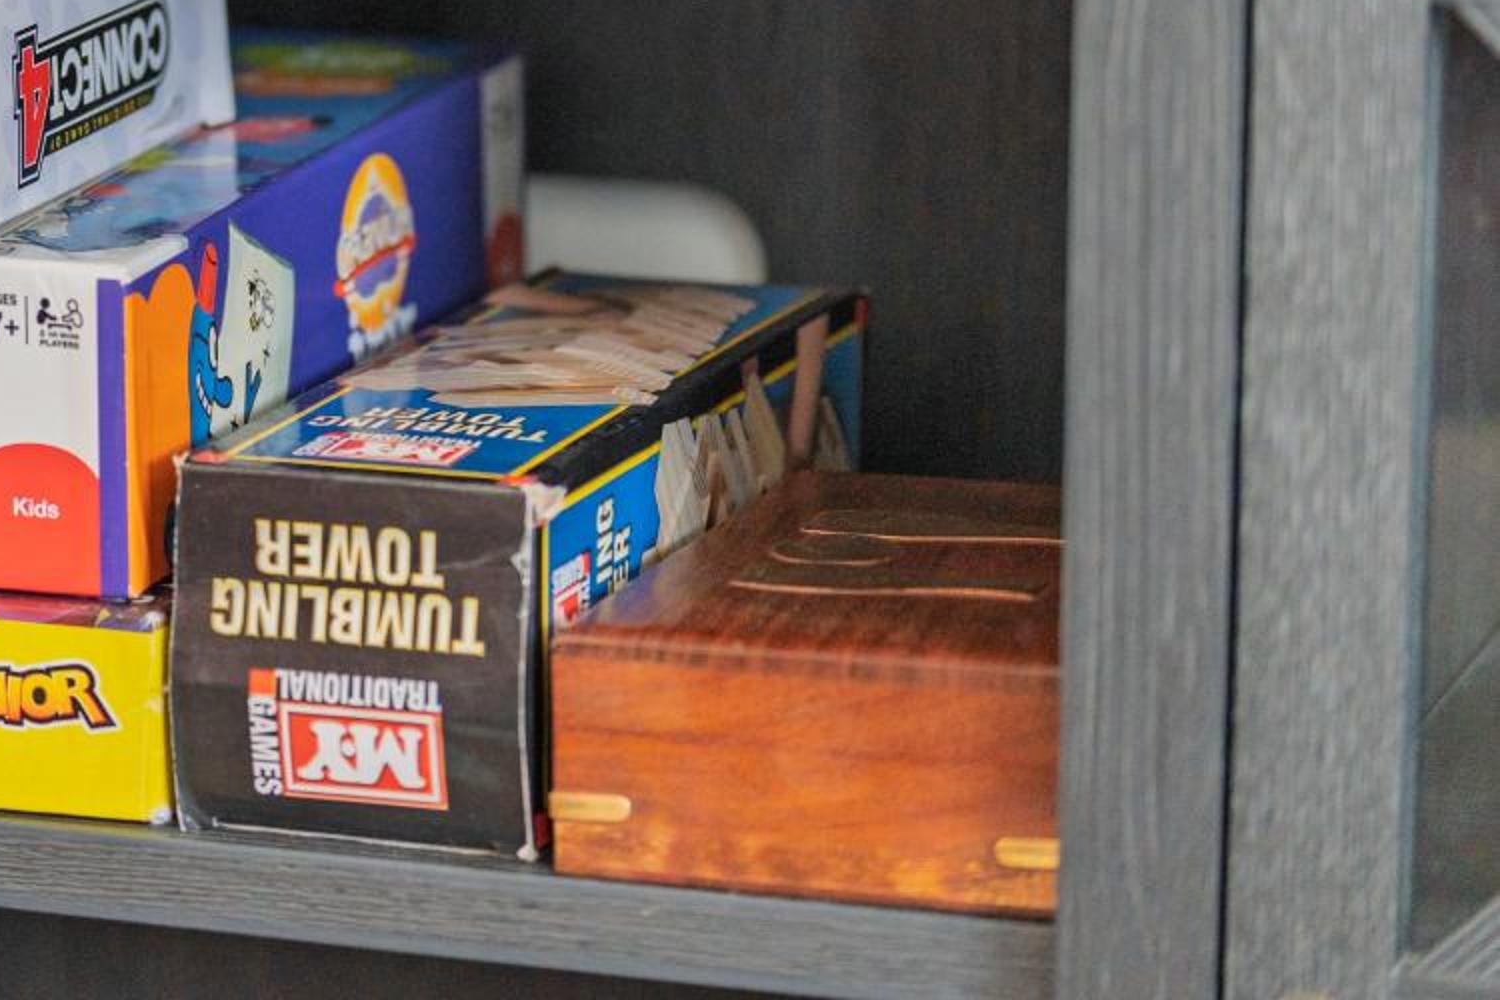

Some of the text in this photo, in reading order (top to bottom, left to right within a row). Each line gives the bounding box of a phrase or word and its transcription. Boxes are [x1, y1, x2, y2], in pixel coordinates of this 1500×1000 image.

[21, 9, 166, 167] CONNECT 4
[306, 414, 549, 443] TUMBLING
[364, 407, 527, 428] TOWER
[11, 497, 60, 519] Kids
[254, 519, 446, 589] TOWER
[209, 577, 485, 657] TUMBLING
[275, 668, 443, 712] TRADITIONAL
[247, 696, 283, 797] GAMES
